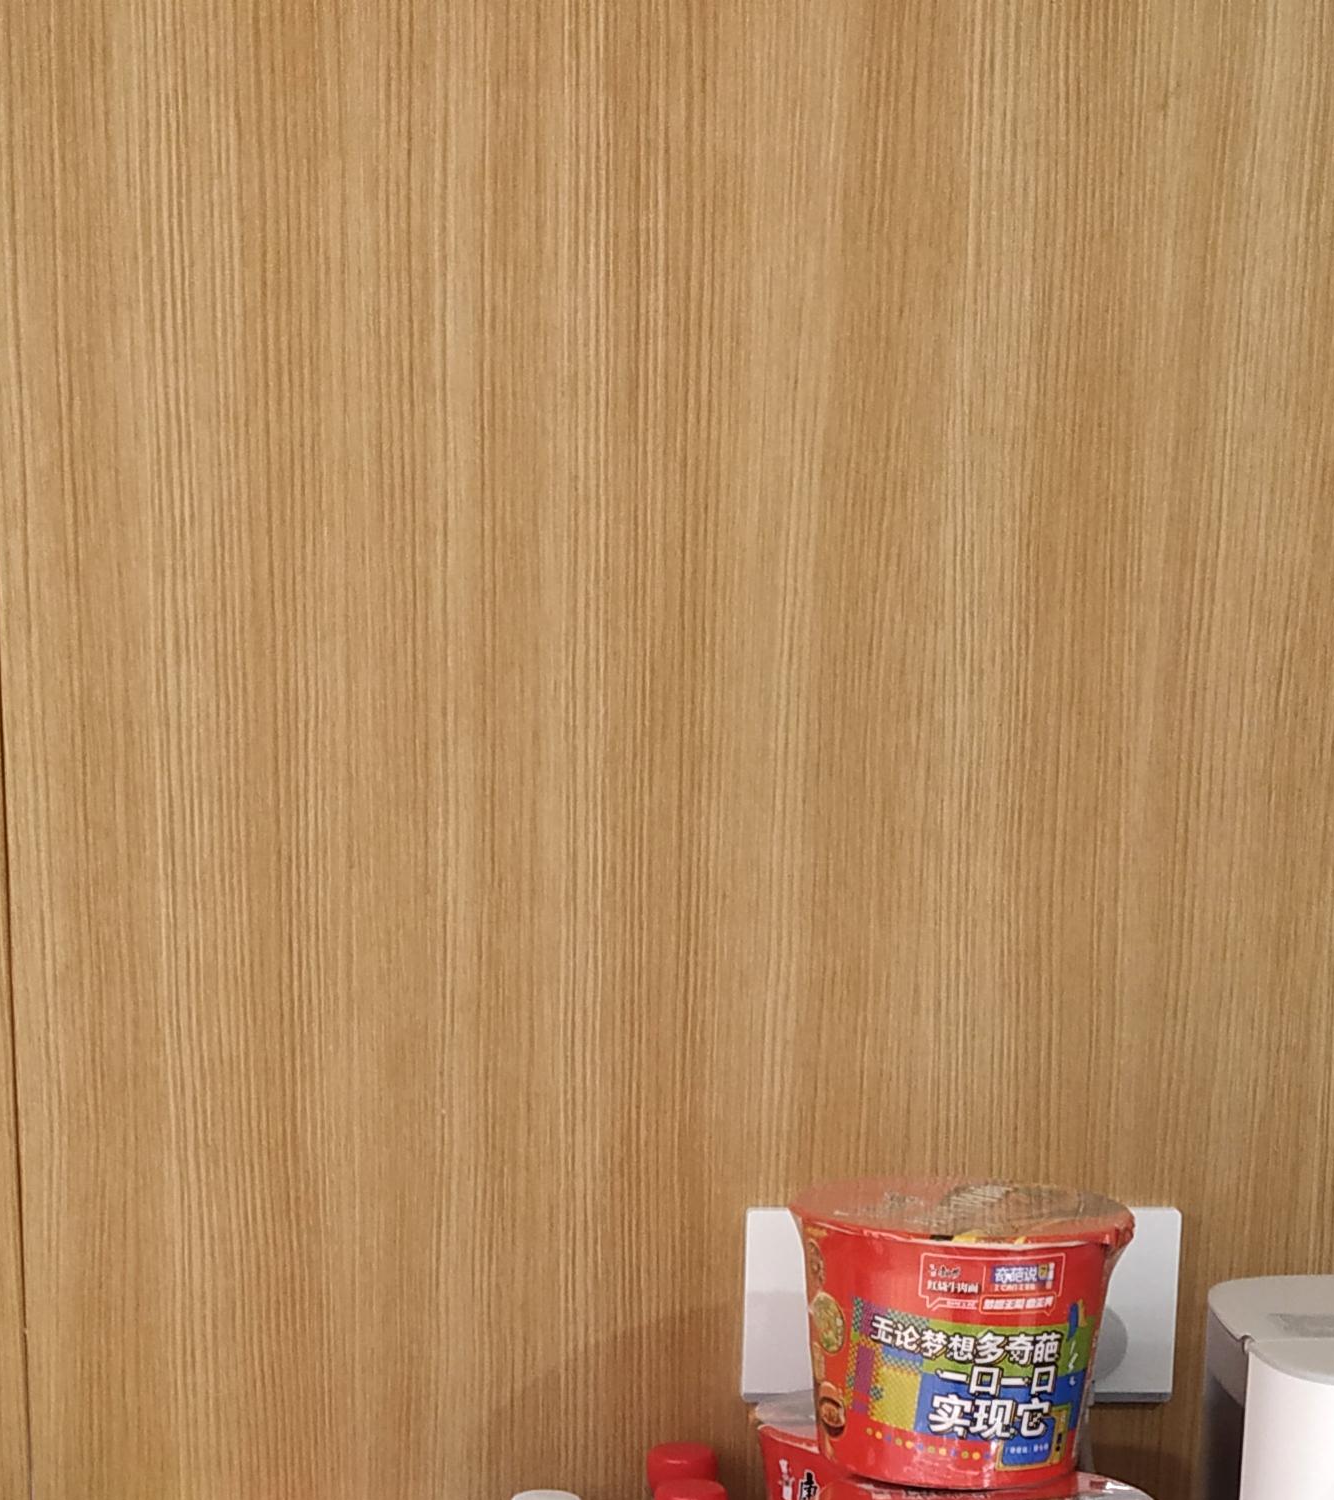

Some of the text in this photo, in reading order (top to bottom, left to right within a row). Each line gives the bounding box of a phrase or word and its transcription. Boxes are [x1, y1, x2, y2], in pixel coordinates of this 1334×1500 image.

[871, 1315, 1062, 1364] 无论梦想多奇葩
[937, 1365, 1057, 1396] 一口一口
[929, 1395, 1049, 1438] 实现它
